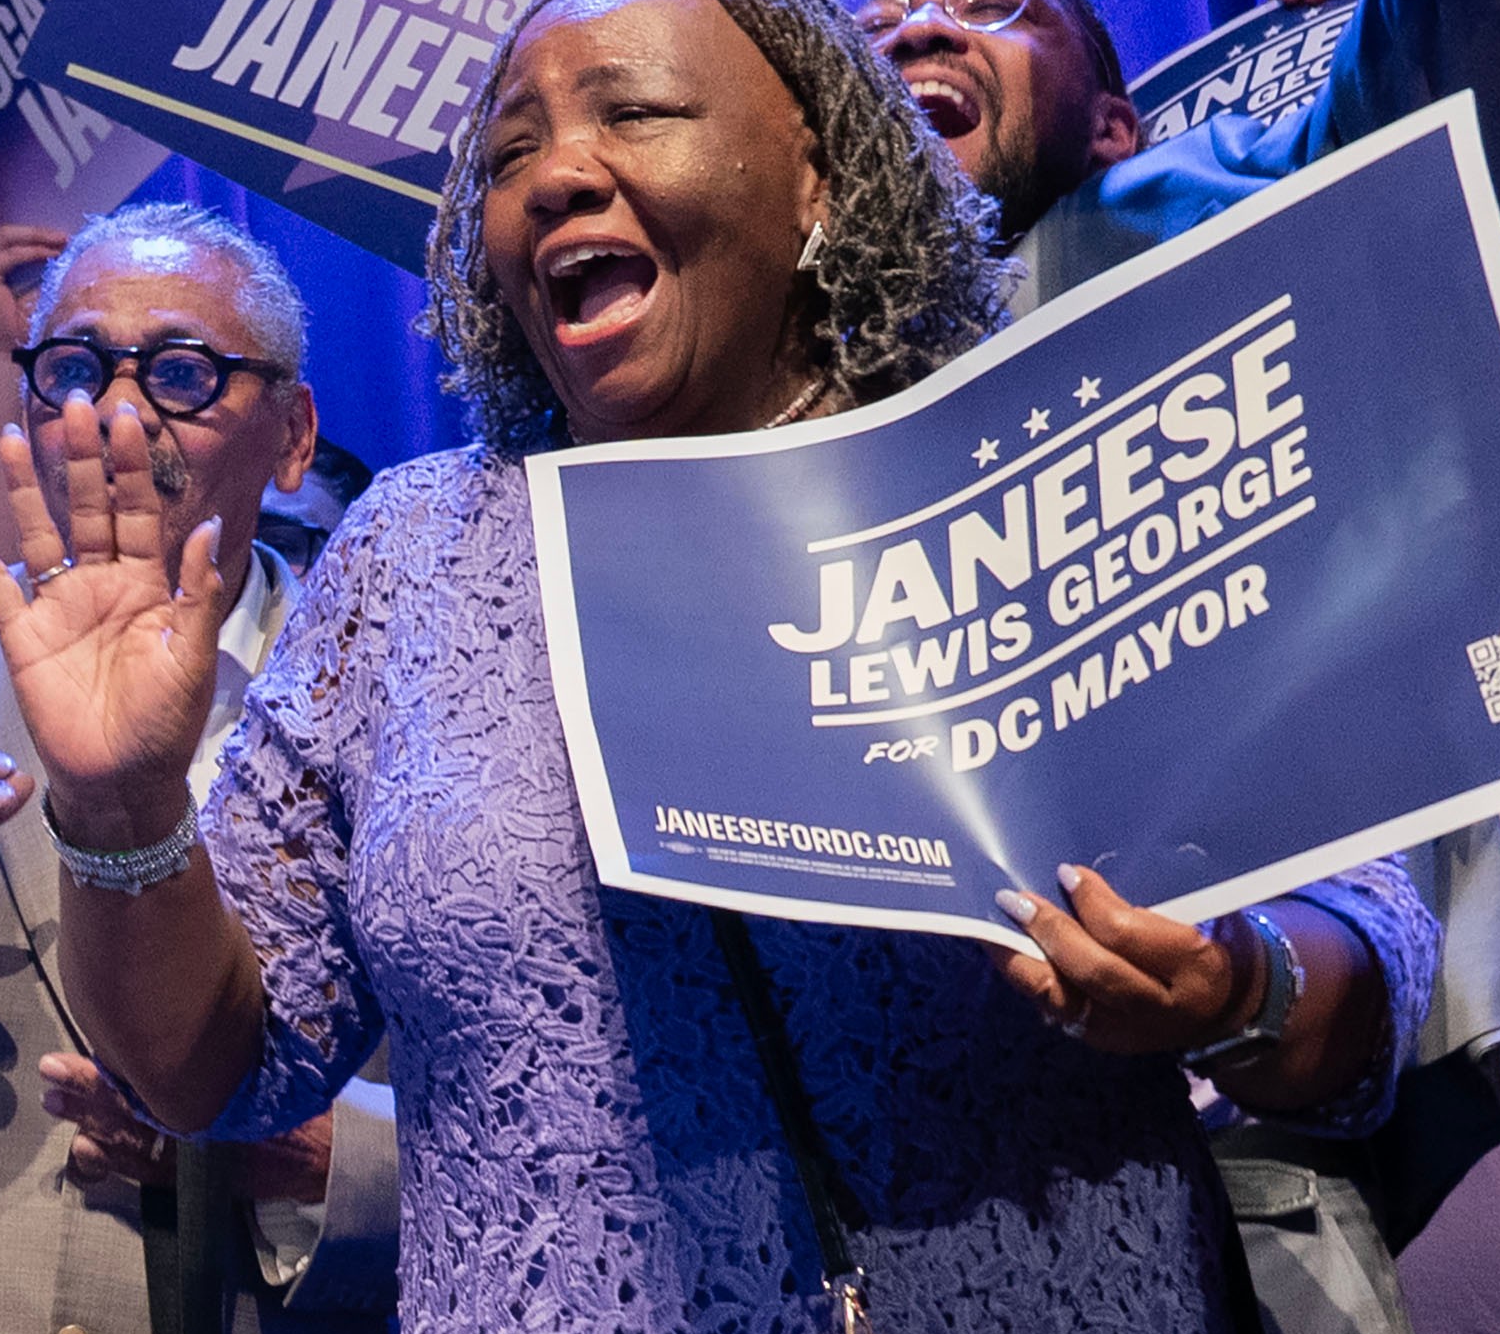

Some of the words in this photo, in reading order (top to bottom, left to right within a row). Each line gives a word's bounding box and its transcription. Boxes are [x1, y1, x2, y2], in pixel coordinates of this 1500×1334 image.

[767, 318, 1304, 655] JANEESE
[809, 599, 1034, 712] LEWIS
[1046, 425, 1313, 627] GEORGE
[864, 732, 940, 767] FOR
[950, 697, 1044, 772] DC
[1053, 564, 1270, 732] MAYOR
[655, 804, 952, 868] JANEESEFORDC.COM
